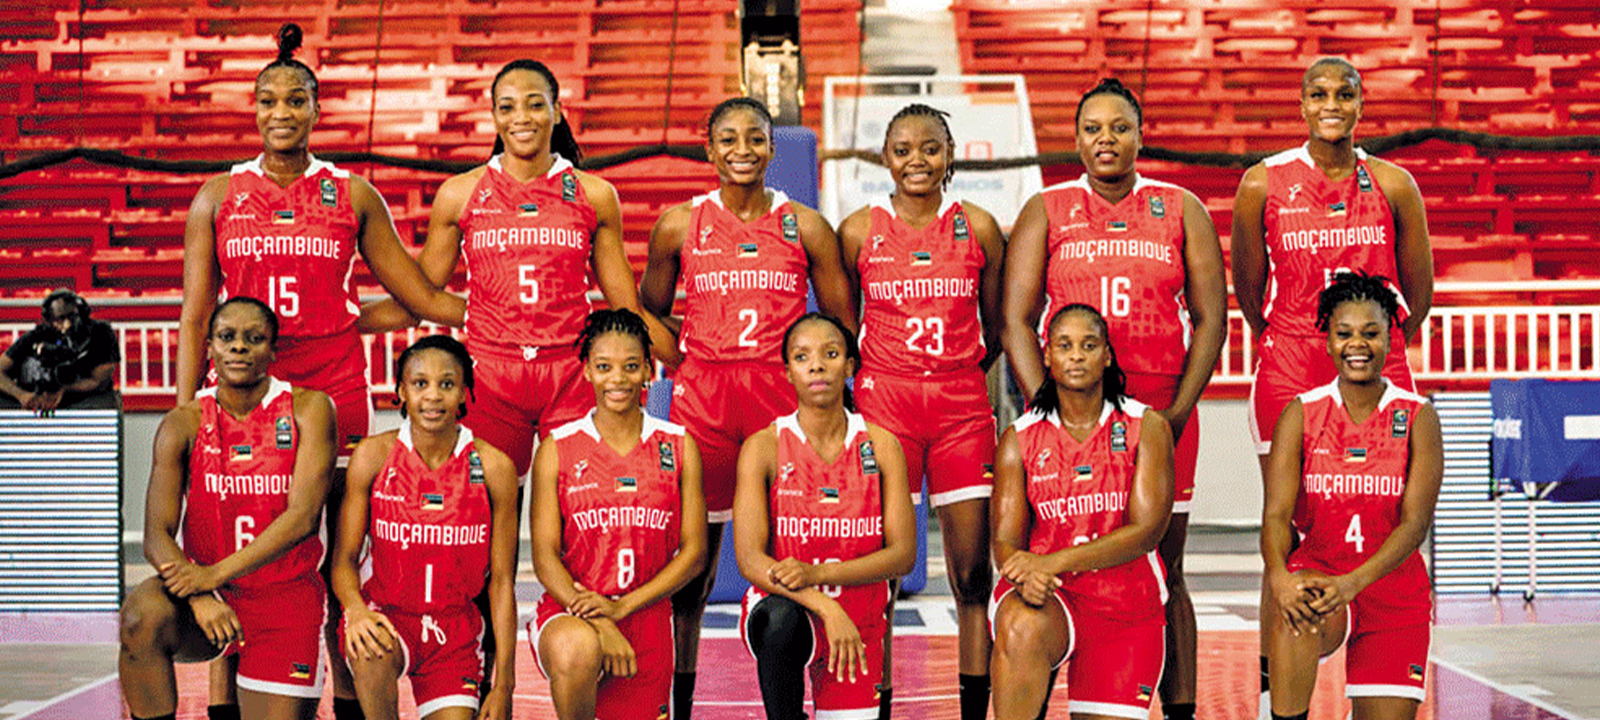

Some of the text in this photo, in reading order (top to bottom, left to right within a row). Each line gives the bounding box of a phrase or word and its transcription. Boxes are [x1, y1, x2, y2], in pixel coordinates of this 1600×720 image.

[227, 236, 340, 261] MOÇAMBIQUE
[473, 228, 582, 251] MOÇAMBIQUE
[1060, 240, 1172, 263] MOÇAMBIQUE
[1283, 226, 1386, 254] MOÇAMBIQUE
[268, 276, 298, 317] 15
[518, 265, 538, 304] 5
[695, 270, 798, 295] MOÇAMBIQUE
[868, 278, 974, 305] MOÇAMBIQUE
[1100, 276, 1131, 317] 16
[738, 309, 759, 347] 2
[905, 316, 944, 356] 23
[235, 515, 255, 551] 6
[376, 518, 487, 549] MOÇAMBIQUE
[1345, 514, 1366, 553] 4
[425, 564, 433, 603] 1
[617, 548, 635, 589] 8
